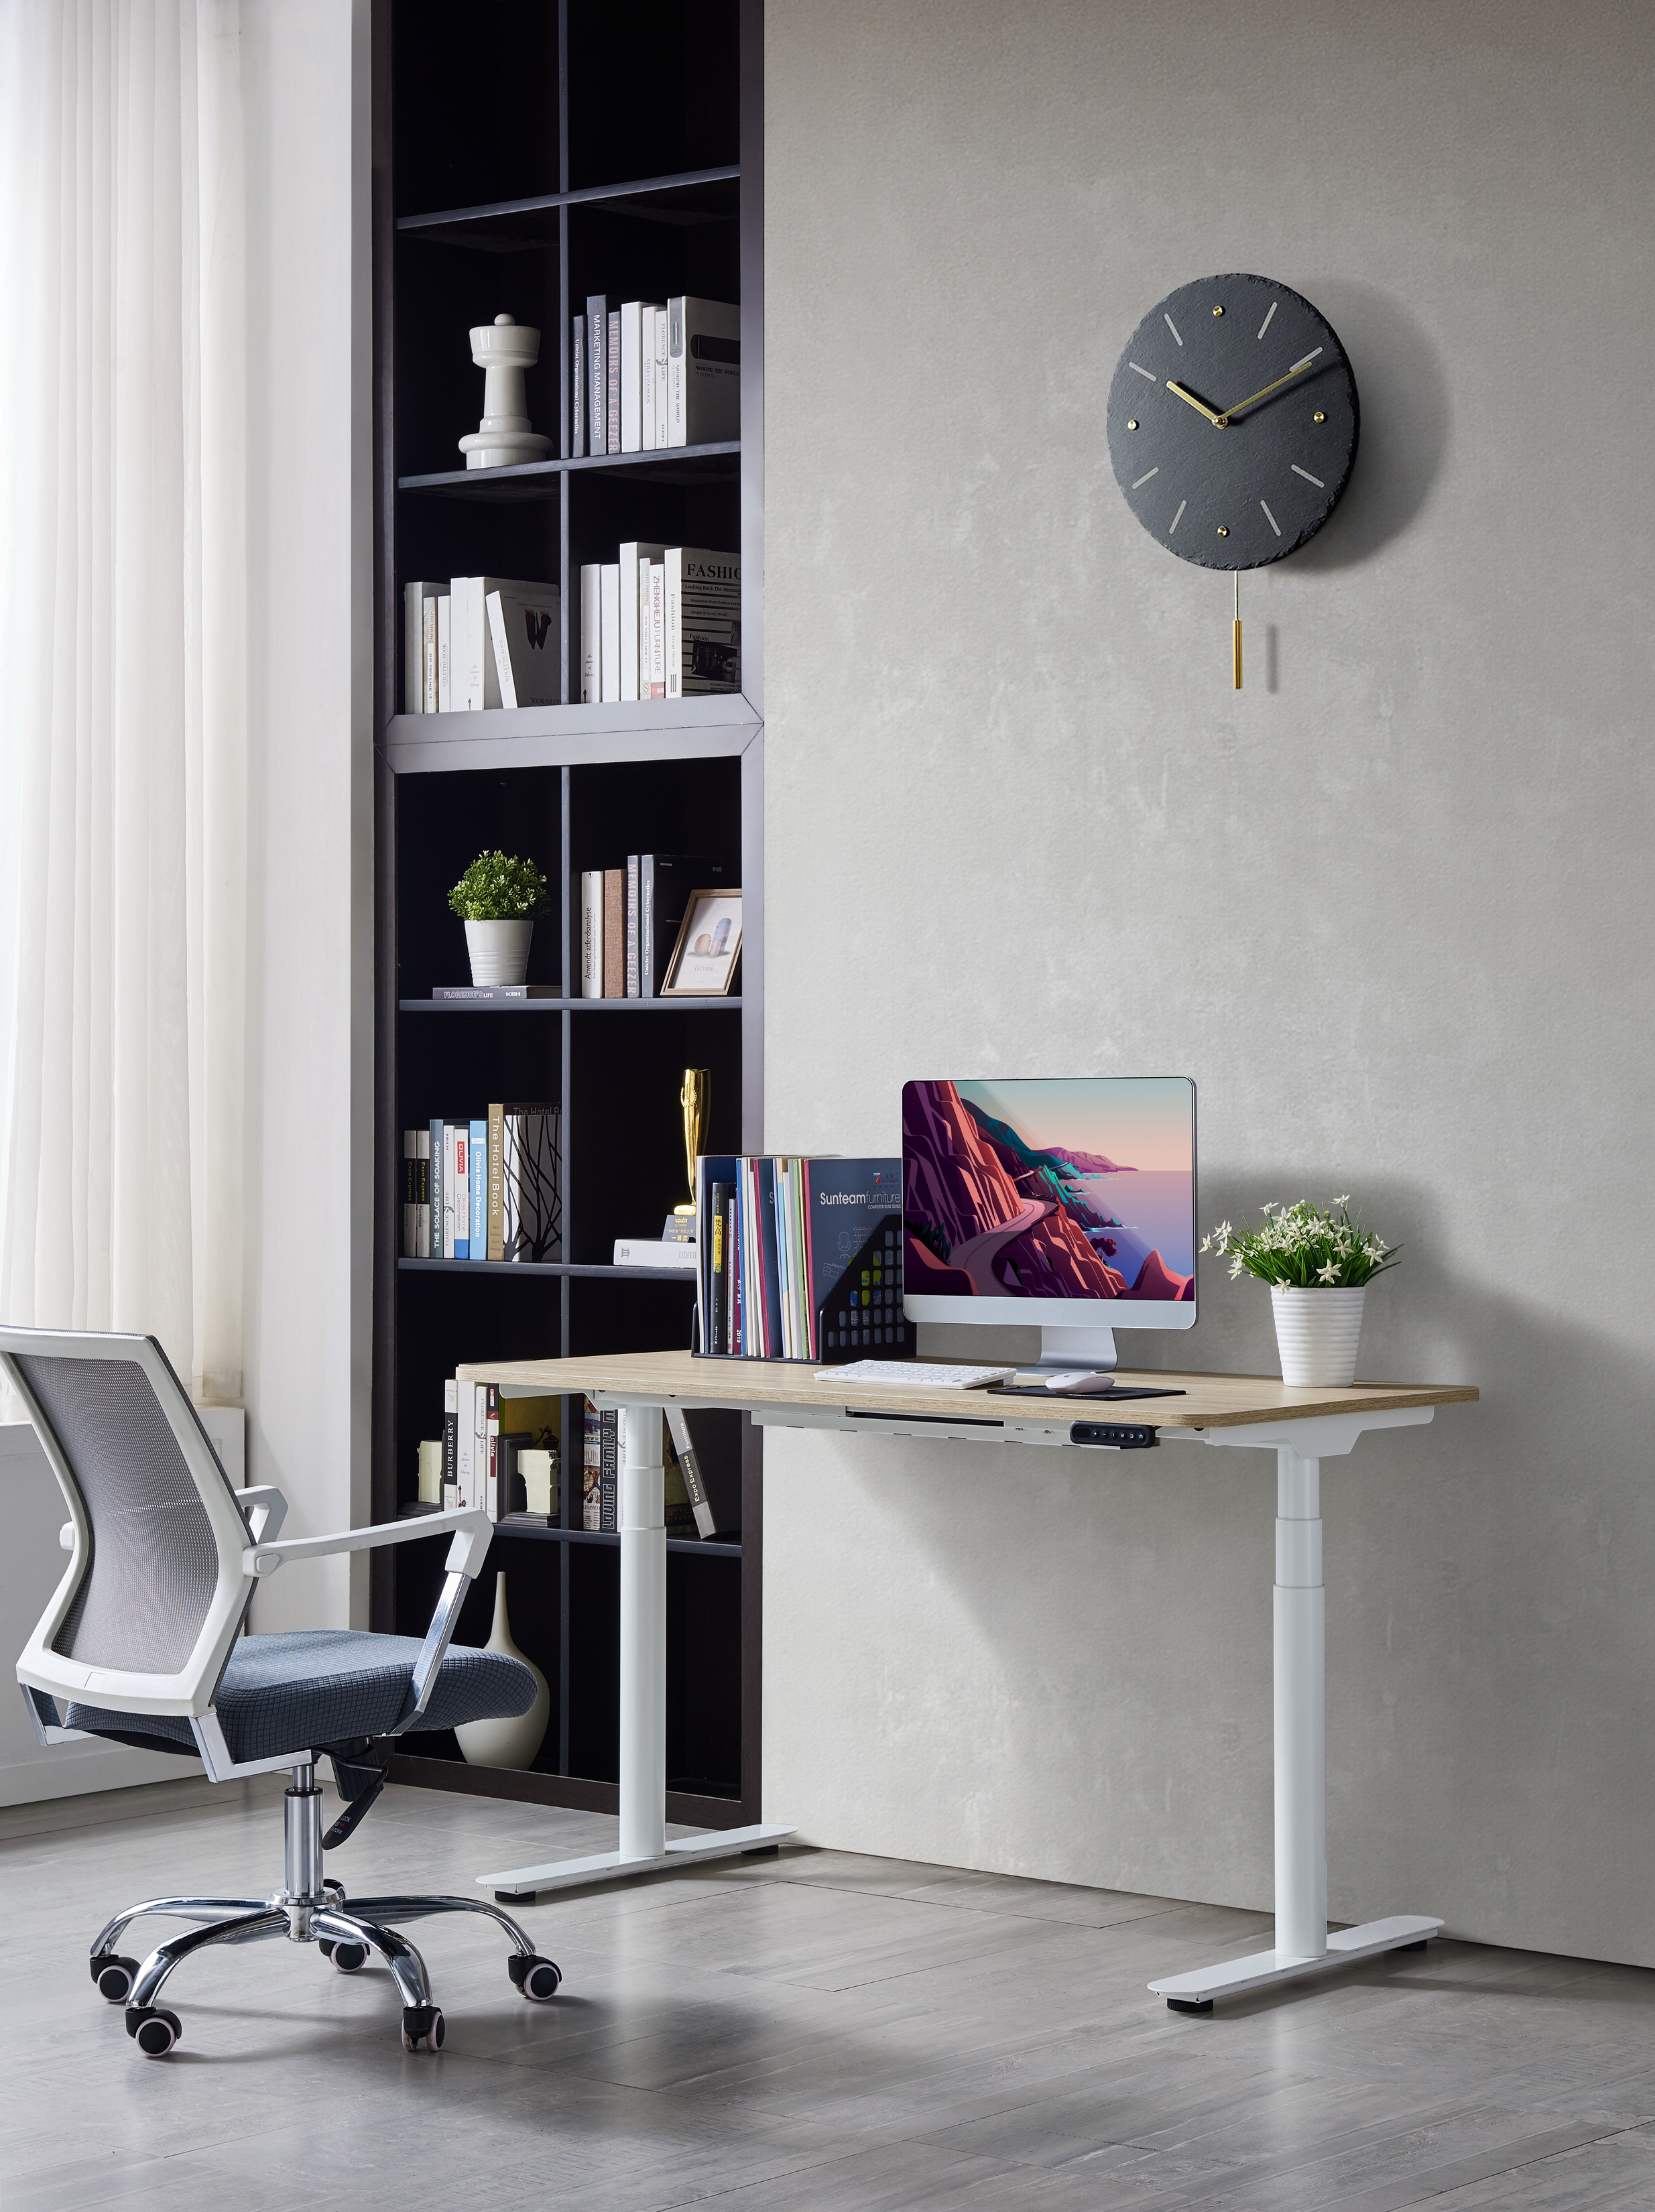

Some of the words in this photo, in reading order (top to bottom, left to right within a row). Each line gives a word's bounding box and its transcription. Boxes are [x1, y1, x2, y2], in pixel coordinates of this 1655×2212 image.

[609, 320, 618, 373] MEMOIRS
[609, 379, 617, 391] OF
[609, 410, 618, 451] GEEZER
[645, 617, 648, 625] DO
[690, 633, 709, 641] Fashion
[429, 654, 432, 662] DO
[628, 864, 636, 916] MEMOIRS
[585, 908, 593, 950] atferdsanalyse
[628, 922, 636, 935] OF
[627, 953, 636, 993] GEEZER
[513, 1107, 528, 1115] The
[531, 1107, 552, 1115] Hotel
[434, 1182, 440, 1193] OF
[680, 1422, 690, 1449] Furniture
[603, 1428, 615, 1478] FAMILY
[684, 1455, 695, 1483] Express
[603, 1484, 615, 1529] LOVING
[692, 1485, 700, 1501] Expo
